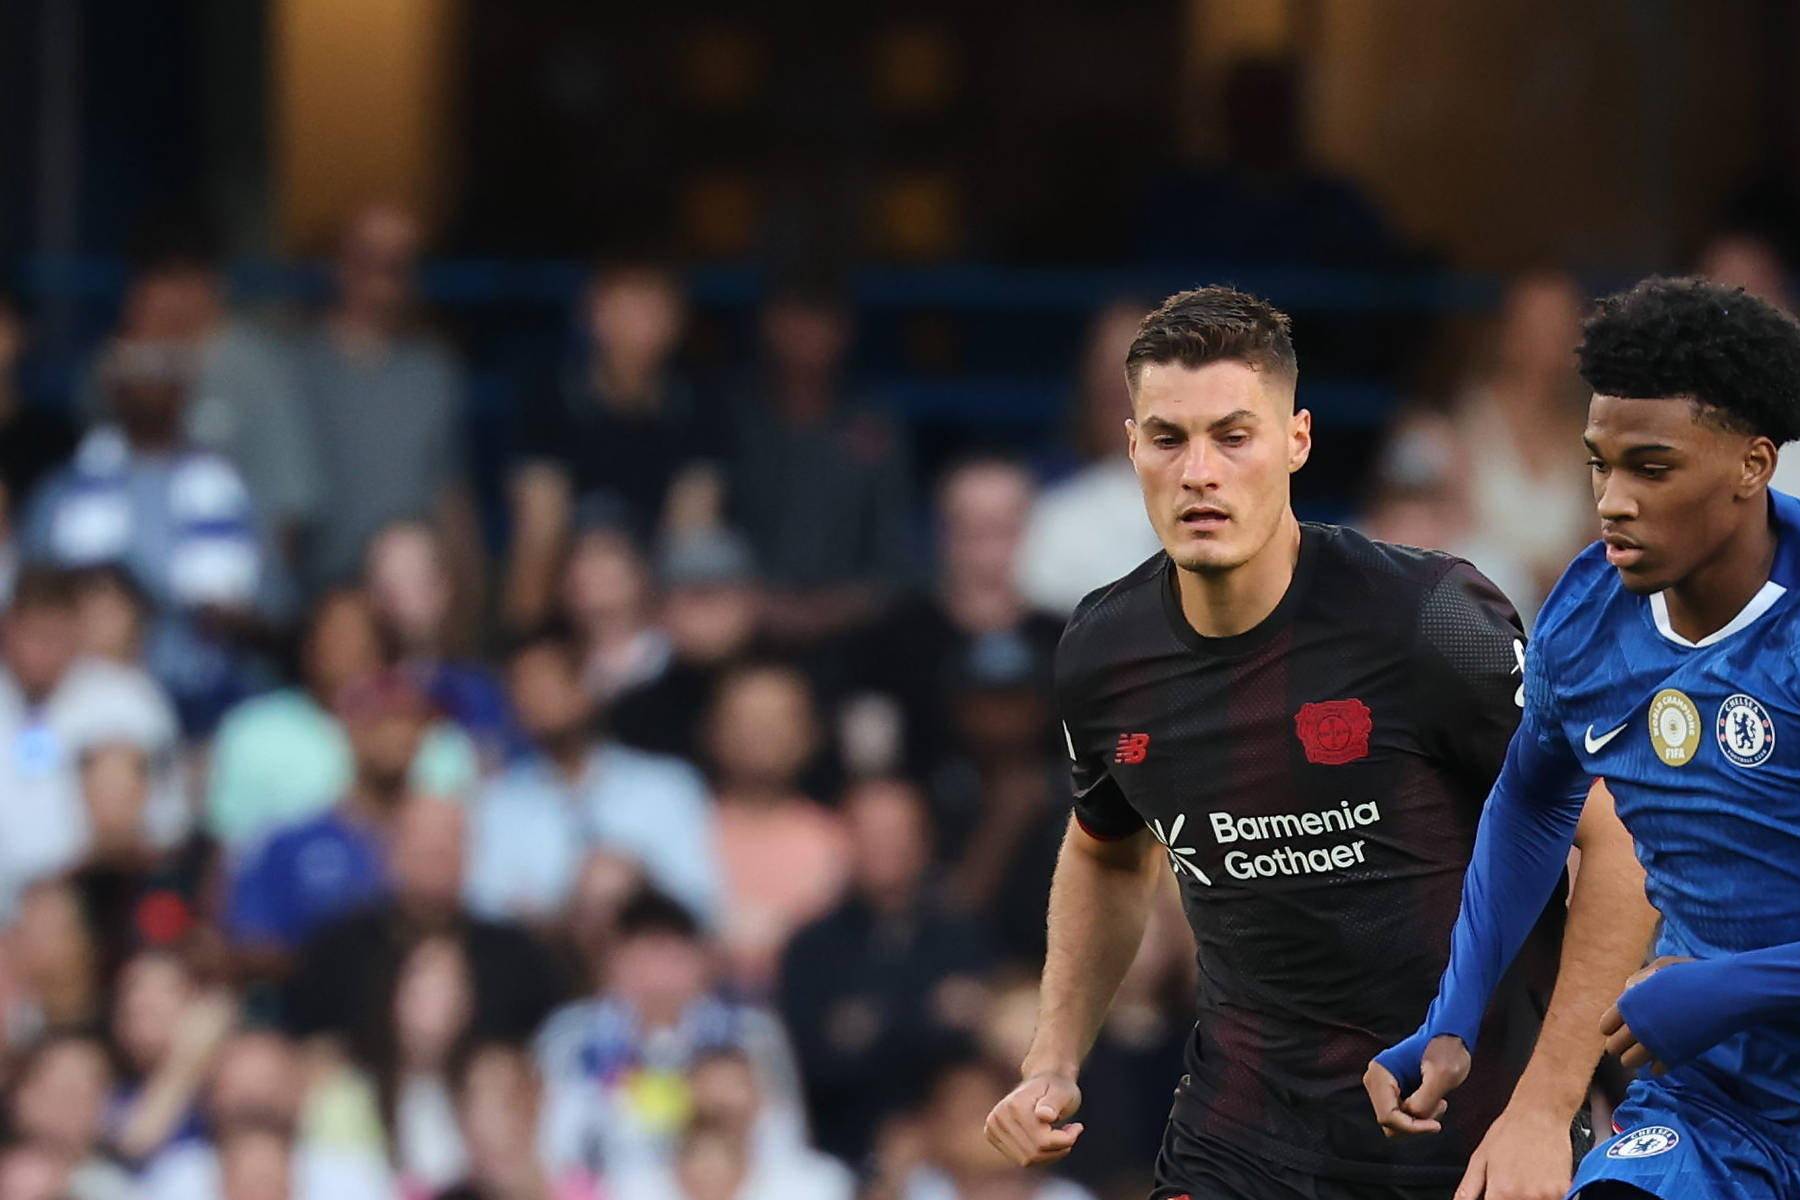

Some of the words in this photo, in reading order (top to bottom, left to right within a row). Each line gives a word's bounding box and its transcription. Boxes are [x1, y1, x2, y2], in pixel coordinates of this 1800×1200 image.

[1725, 697, 1759, 713] CHELSEA
[1665, 747, 1686, 760] FIFA
[1209, 800, 1381, 844] Barmenia
[1224, 840, 1366, 880] Gothaer
